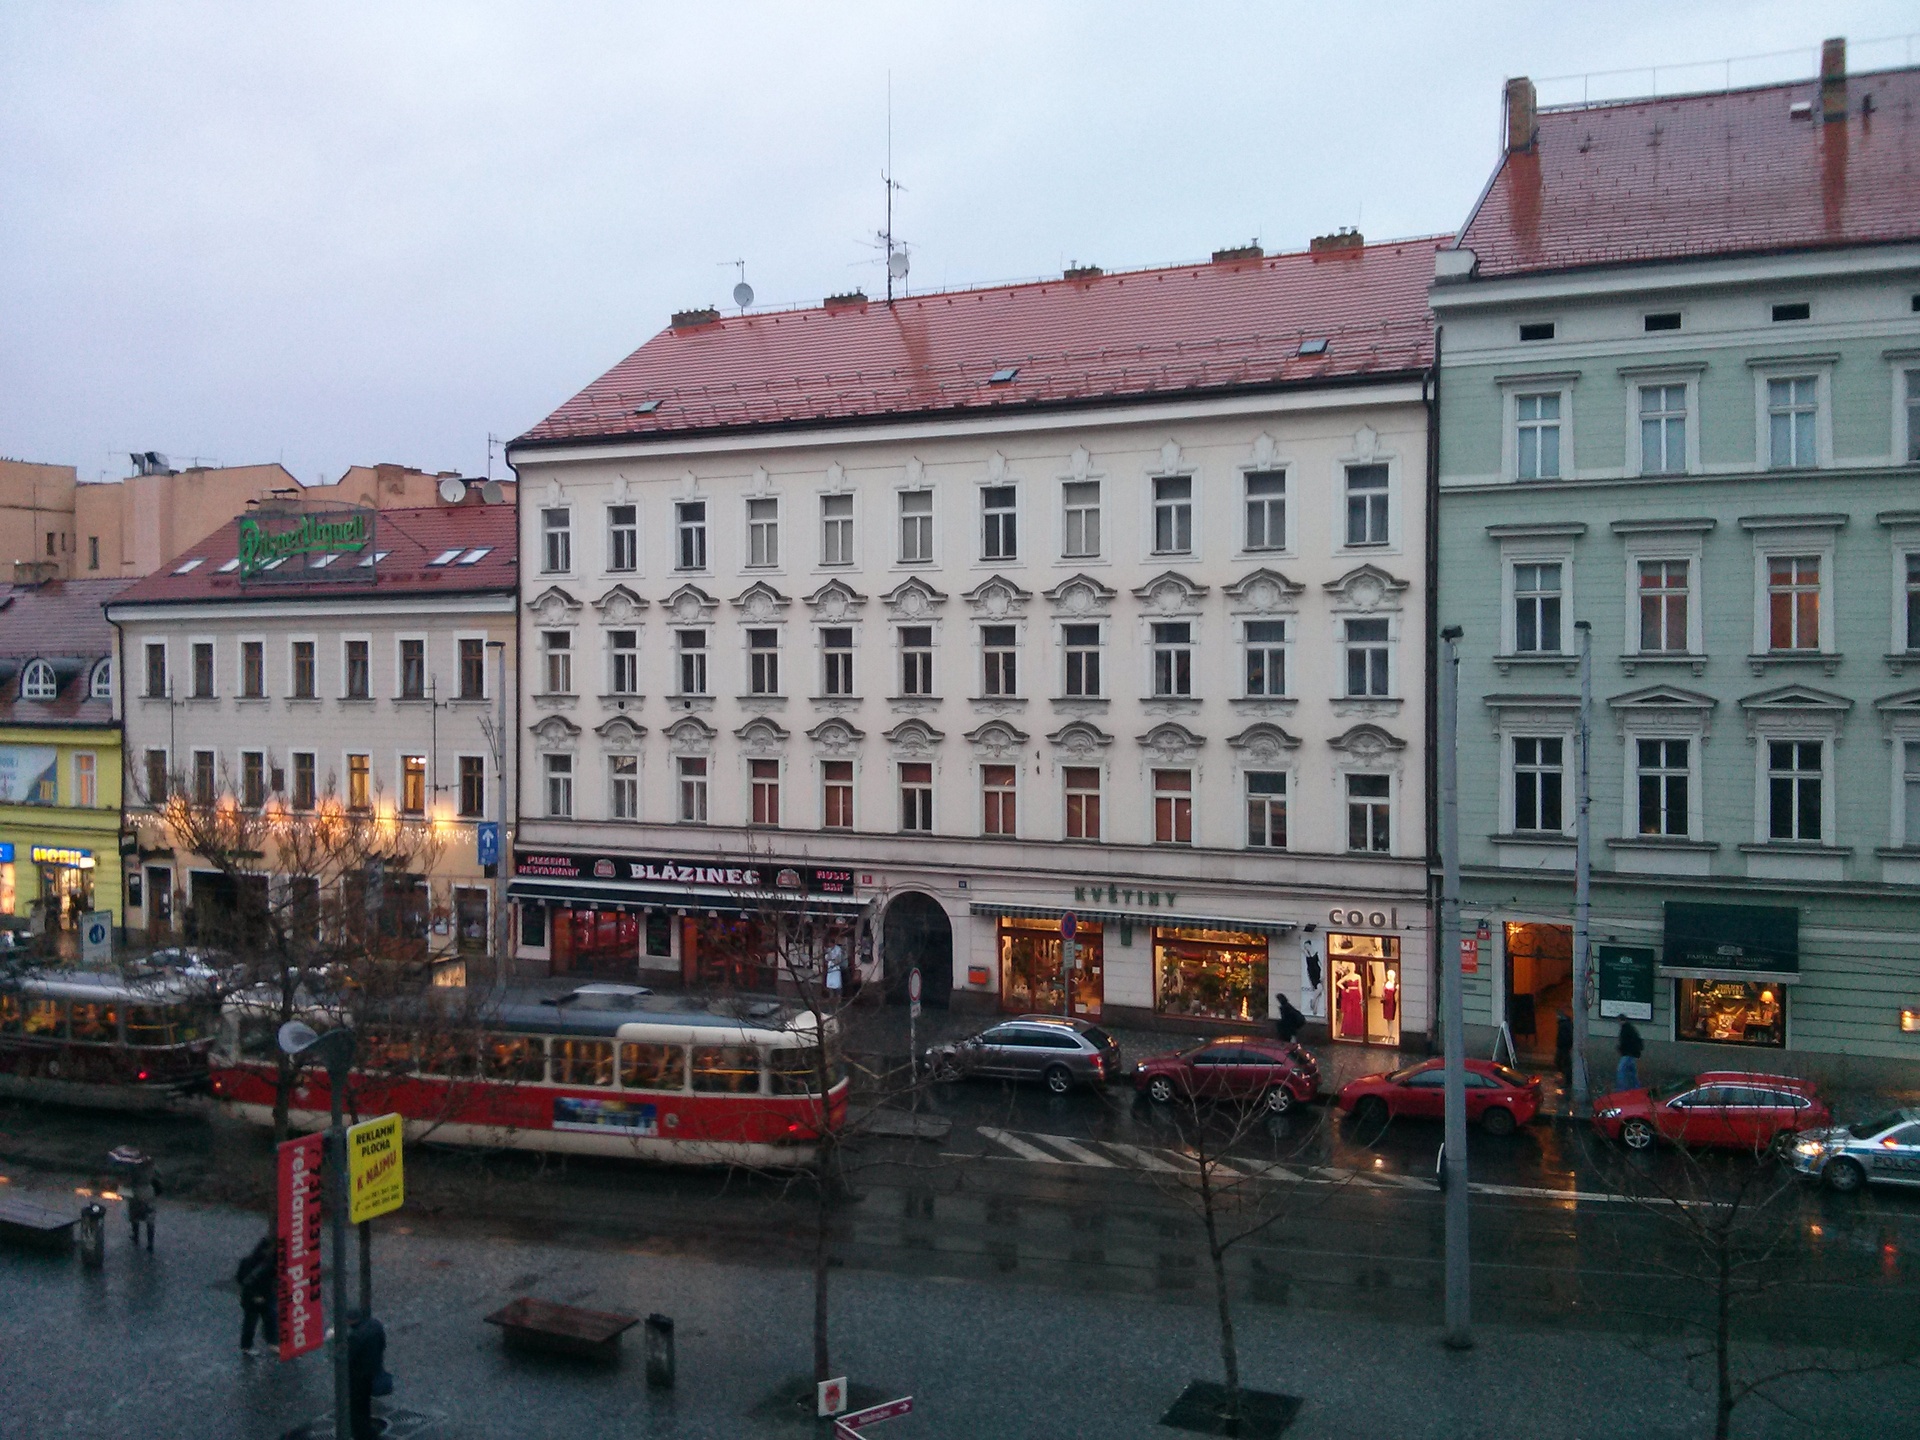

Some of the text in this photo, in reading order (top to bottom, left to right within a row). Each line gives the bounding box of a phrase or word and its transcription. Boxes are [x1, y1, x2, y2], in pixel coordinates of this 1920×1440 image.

[239, 514, 364, 578] Pilsner Urquell
[518, 864, 580, 877] RESTAURANT
[526, 855, 572, 867] PIZZERIE
[629, 860, 762, 885] BLÁZINEC
[816, 869, 851, 881] MUSIC
[823, 882, 844, 893] BAR
[1074, 882, 1177, 908] KVĚTINY
[355, 1122, 396, 1146] REKLAMNÍ
[361, 1138, 391, 1158] PLOCHA
[356, 1174, 364, 1193] K
[365, 1148, 397, 1185] NÁJMU
[287, 1145, 311, 1349] reklamní plocha
